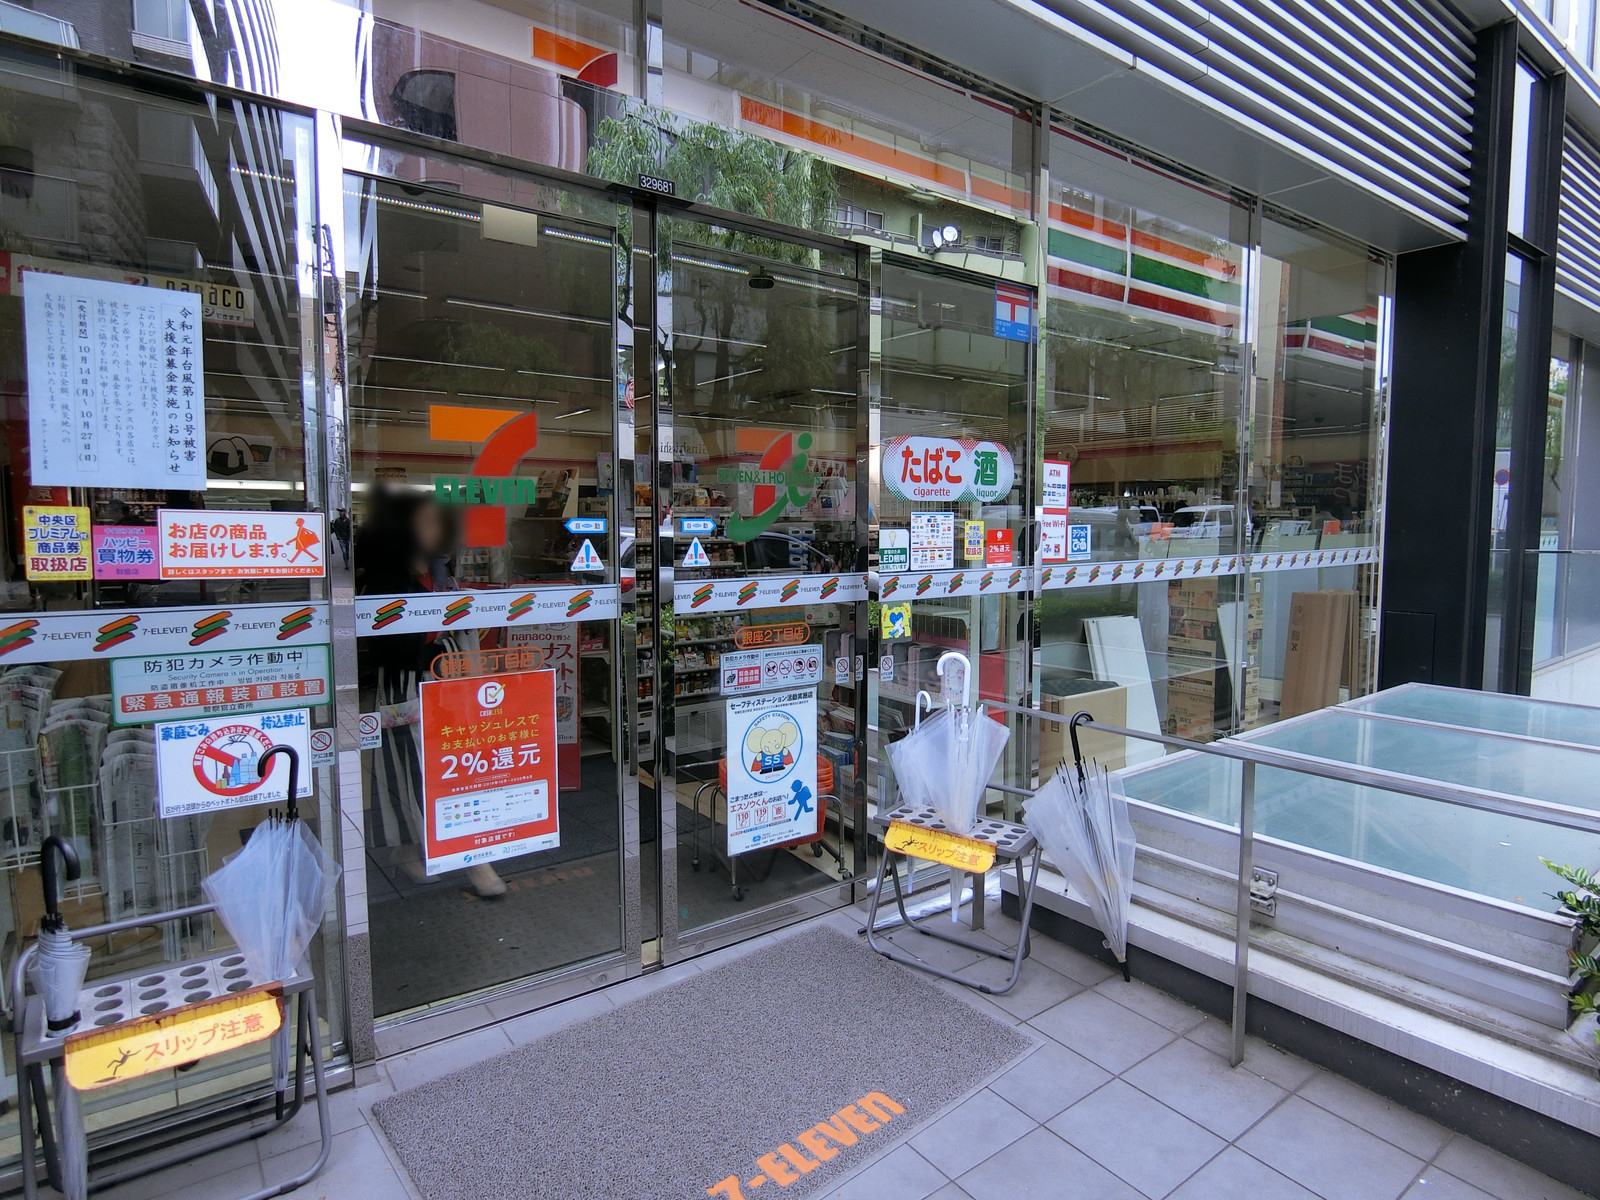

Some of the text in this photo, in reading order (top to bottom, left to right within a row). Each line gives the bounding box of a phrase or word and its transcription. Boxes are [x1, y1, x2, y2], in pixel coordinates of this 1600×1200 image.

[640, 175, 673, 194] 329681
[202, 307, 241, 321] ジできます
[180, 307, 197, 462] 令和元年台風第19号被害
[164, 318, 181, 473] 支援金募金実施のお知らせ
[901, 445, 998, 486] たばこ 酒
[1049, 469, 1061, 477] ATM
[913, 487, 999, 498] cigarette liquor
[38, 515, 77, 526] 中央区
[1053, 520, 1065, 528] Wi-Fi
[168, 522, 267, 540] お店の商品
[37, 542, 81, 554] 商品券
[168, 542, 287, 559] お届けします。
[1072, 539, 1087, 552] ぴあ
[30, 557, 87, 572] 取扱店
[98, 549, 154, 564] 買物券
[741, 627, 805, 645] 銀座2丁目店
[144, 650, 303, 674] 防犯カメラ作動中
[168, 673, 199, 682] Security
[199, 670, 229, 679] Camera
[247, 666, 283, 675] Operation
[125, 680, 322, 711] 緊急通報装置設置
[203, 703, 254, 713] 警察官立寄所
[480, 708, 503, 717] CASHLESS
[261, 712, 305, 730] 持込禁止
[440, 714, 540, 738] キャッシュレスで
[161, 723, 211, 741] 家庭ごみ
[441, 729, 540, 751] お支払いのお客様に
[440, 743, 541, 780] 2%還元
[764, 754, 781, 766] SS
[737, 812, 749, 820] 110
[755, 808, 767, 817] 119
[916, 842, 981, 866] スリップ注意
[144, 1012, 265, 1062] スリップ注意
